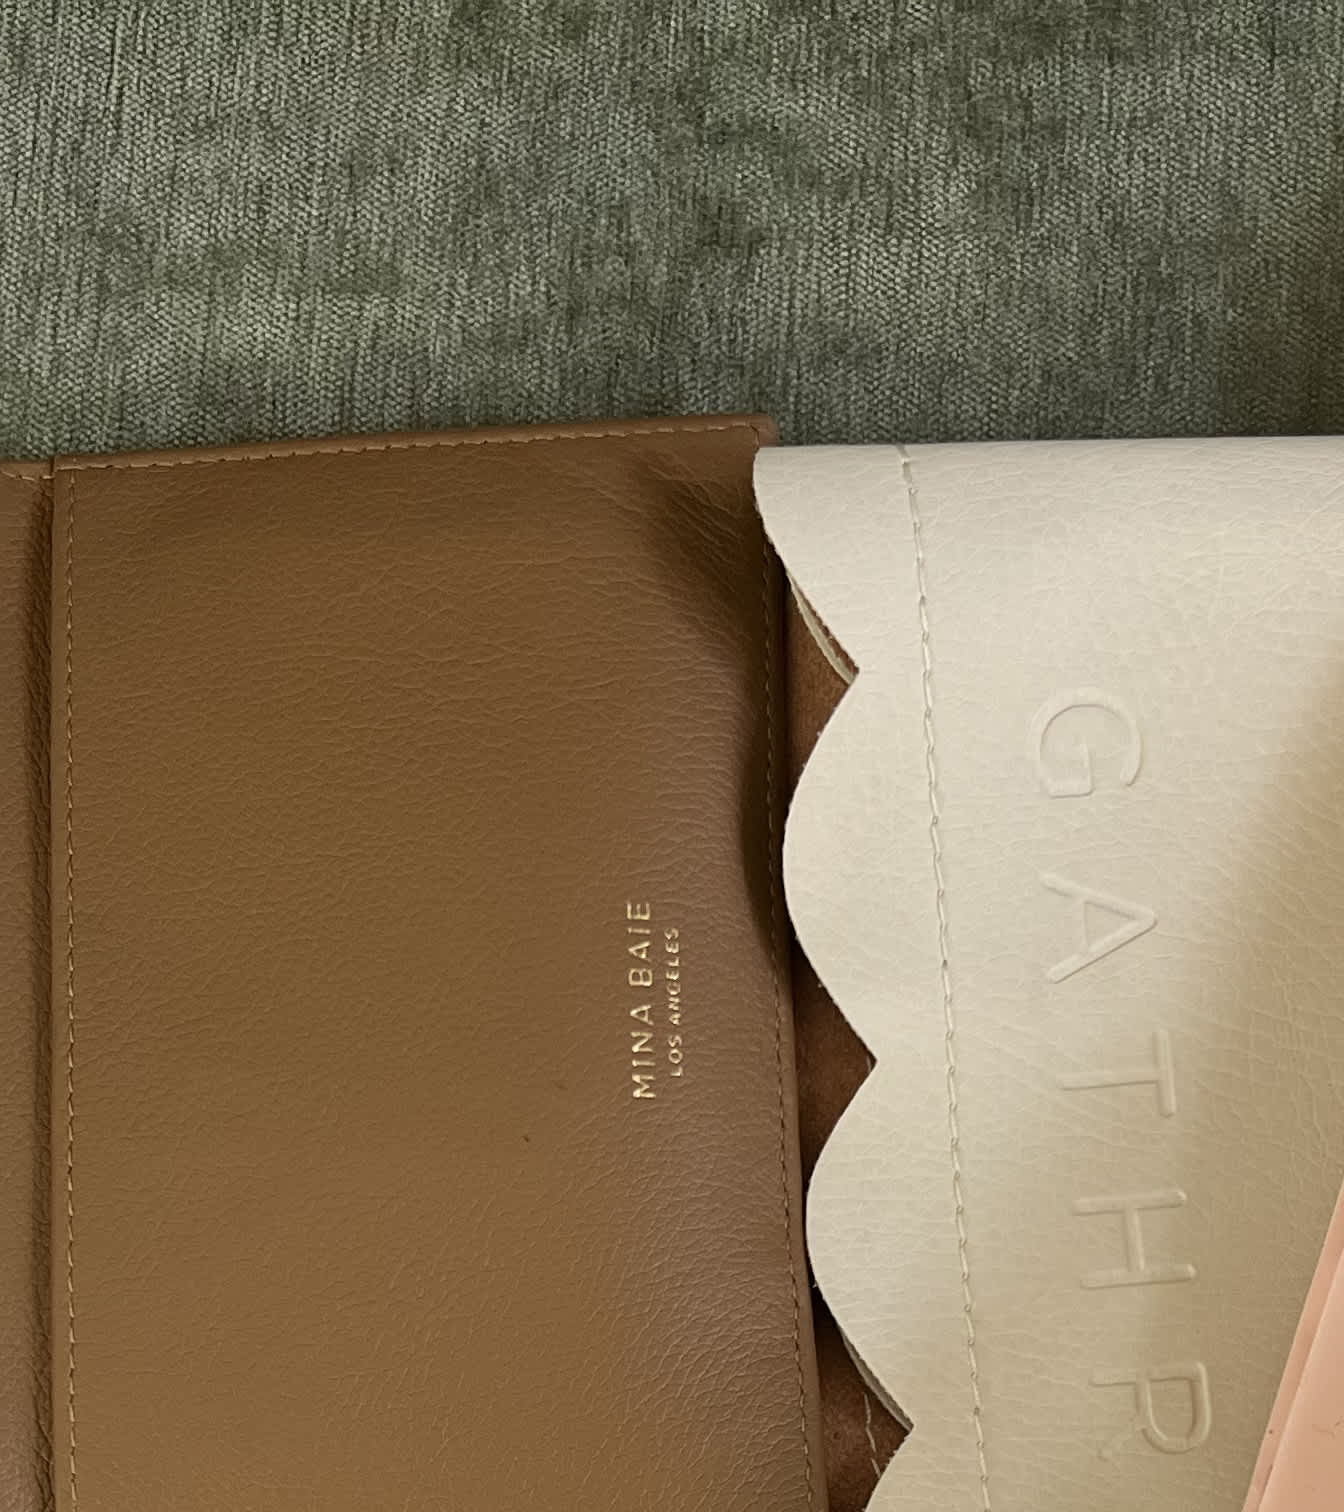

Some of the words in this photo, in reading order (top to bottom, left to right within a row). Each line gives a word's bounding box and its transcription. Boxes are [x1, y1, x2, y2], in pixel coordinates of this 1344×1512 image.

[626, 901, 654, 988] BAIE
[664, 927, 681, 1026] ANGELES
[629, 1003, 657, 1100] MINA
[667, 1034, 684, 1078] LOS
